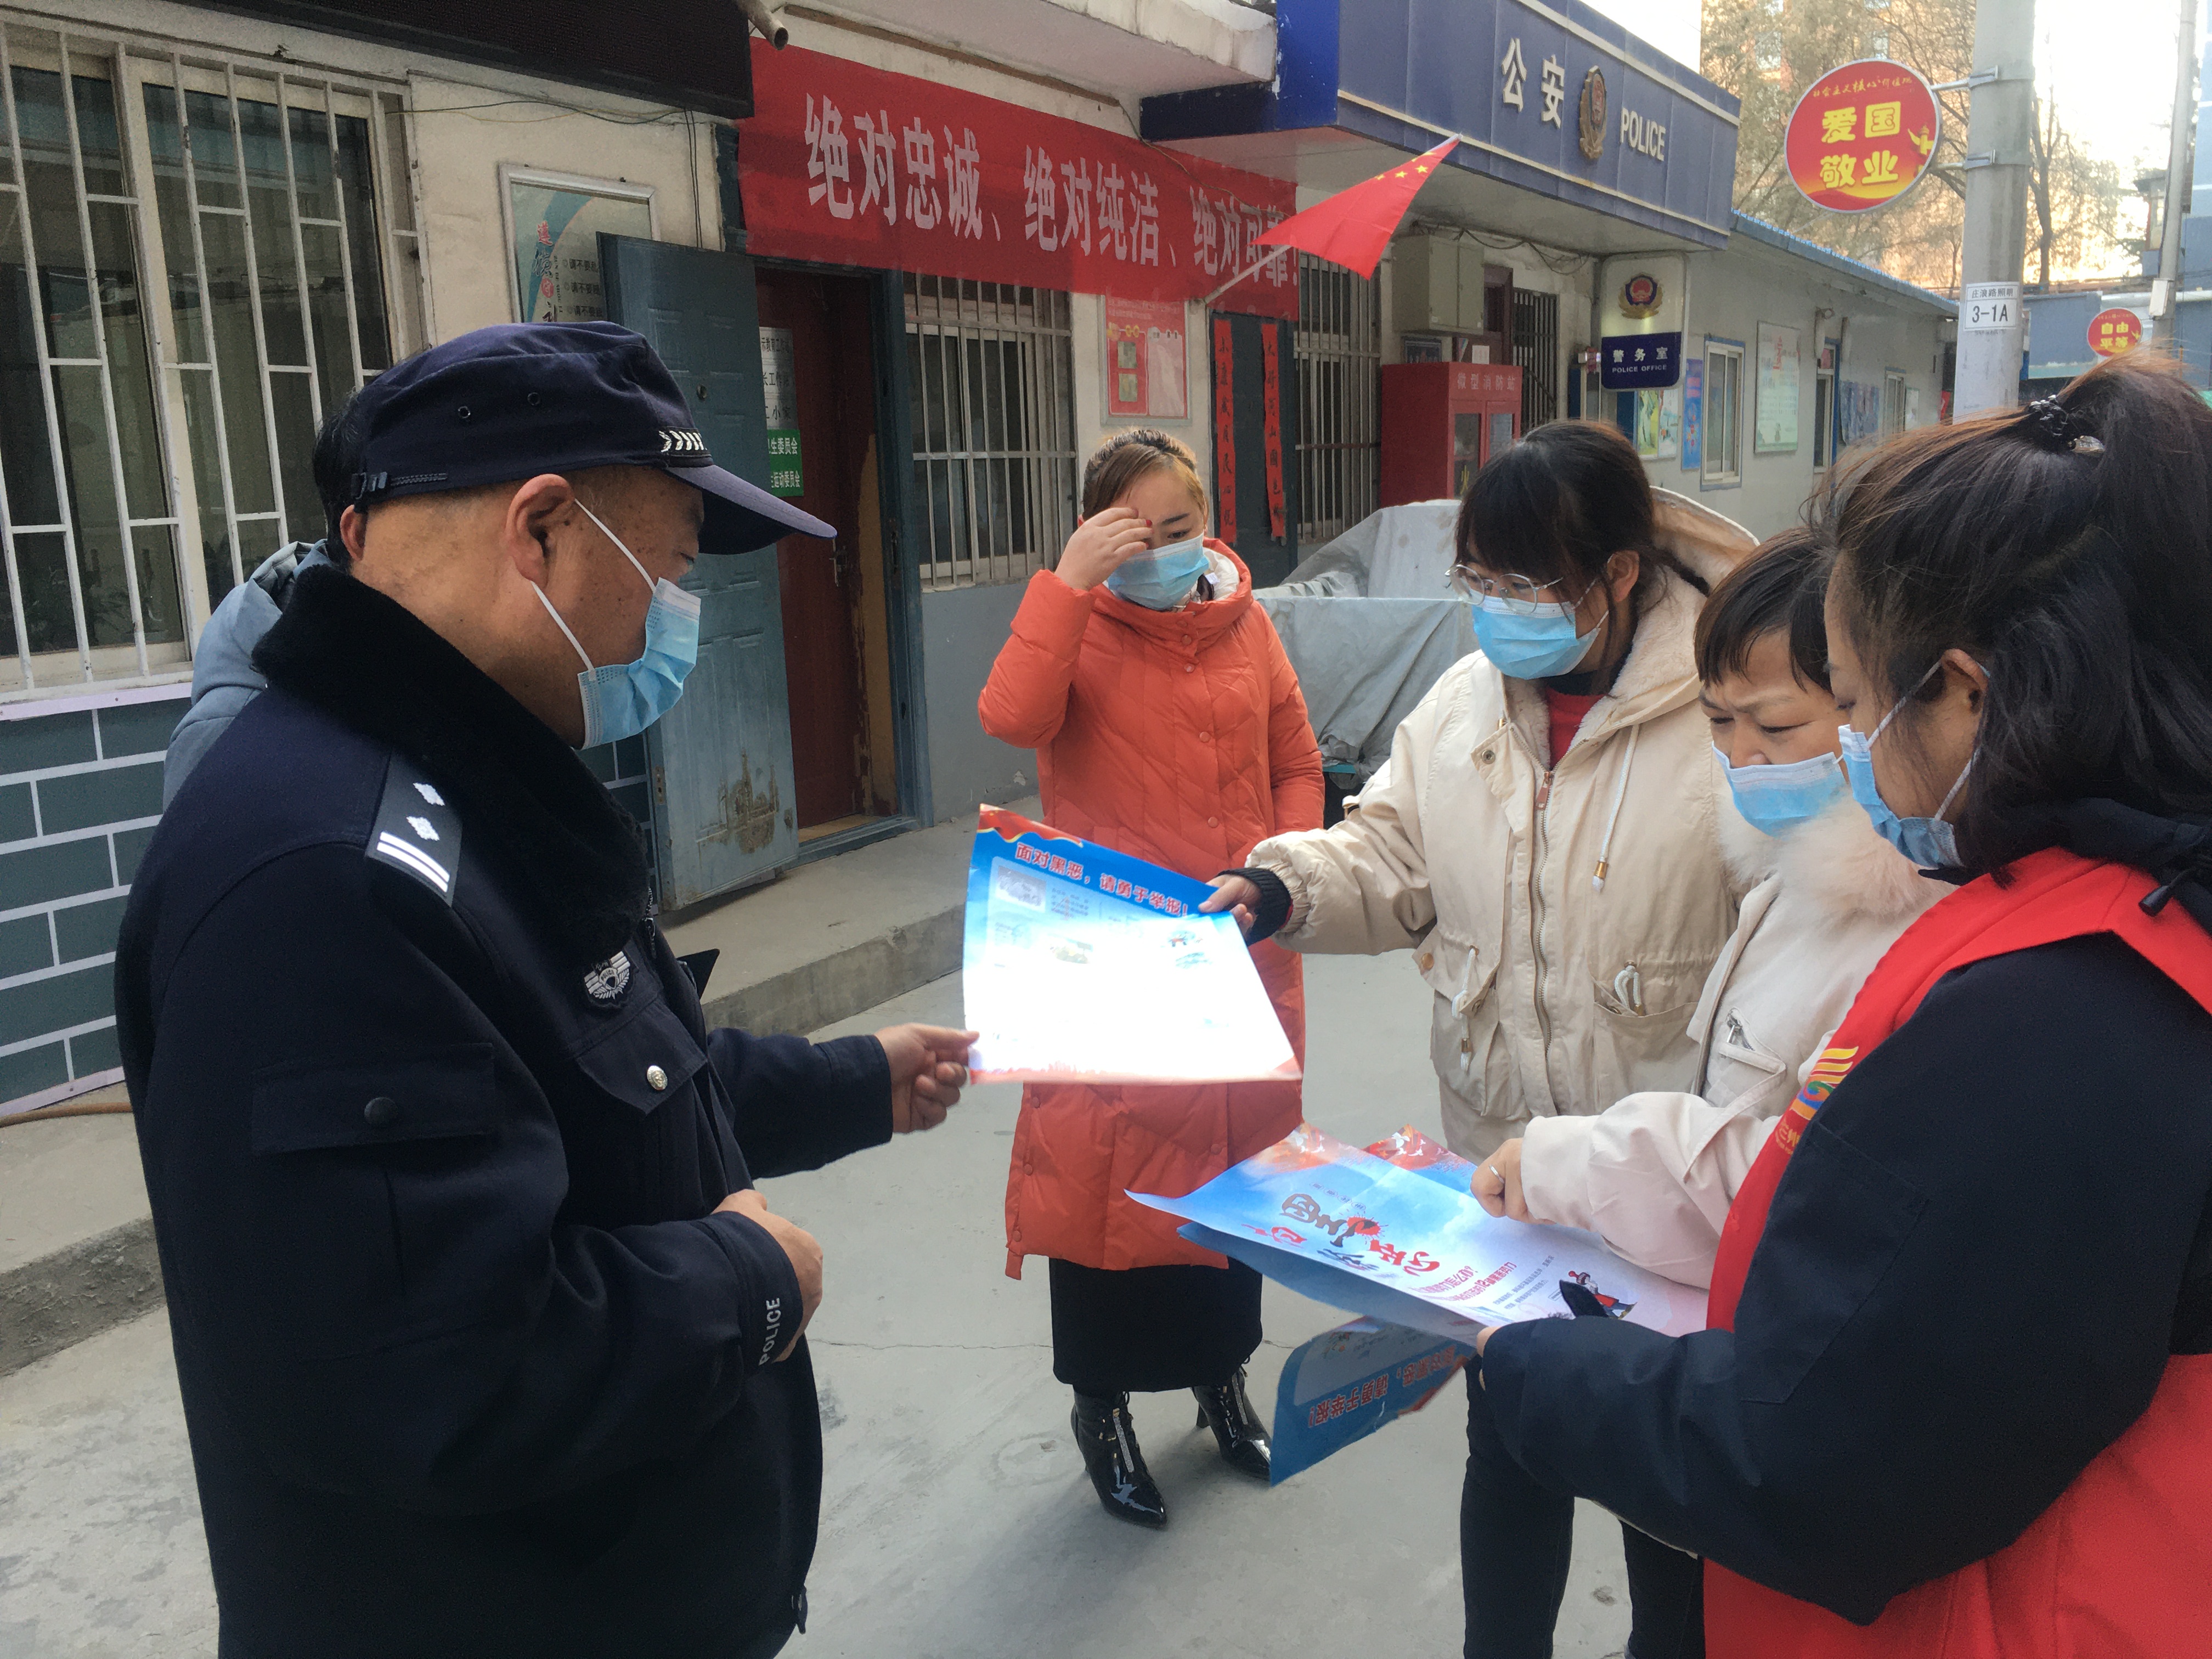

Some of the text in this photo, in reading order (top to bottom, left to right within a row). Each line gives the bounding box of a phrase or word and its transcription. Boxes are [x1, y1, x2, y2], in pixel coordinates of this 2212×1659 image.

[1502, 38, 1565, 129] 公安
[1620, 107, 1666, 162] POLICE
[1821, 101, 1901, 144] 爱国
[1820, 150, 1899, 189] 敬业
[1972, 287, 2013, 299] 庄浪路照明
[1972, 303, 2008, 323] 3-1A
[2101, 321, 2129, 335] 自由
[1612, 346, 1668, 363] 警务室
[1457, 373, 1517, 391] 微型消防站
[758, 1297, 782, 1366] POLICE
